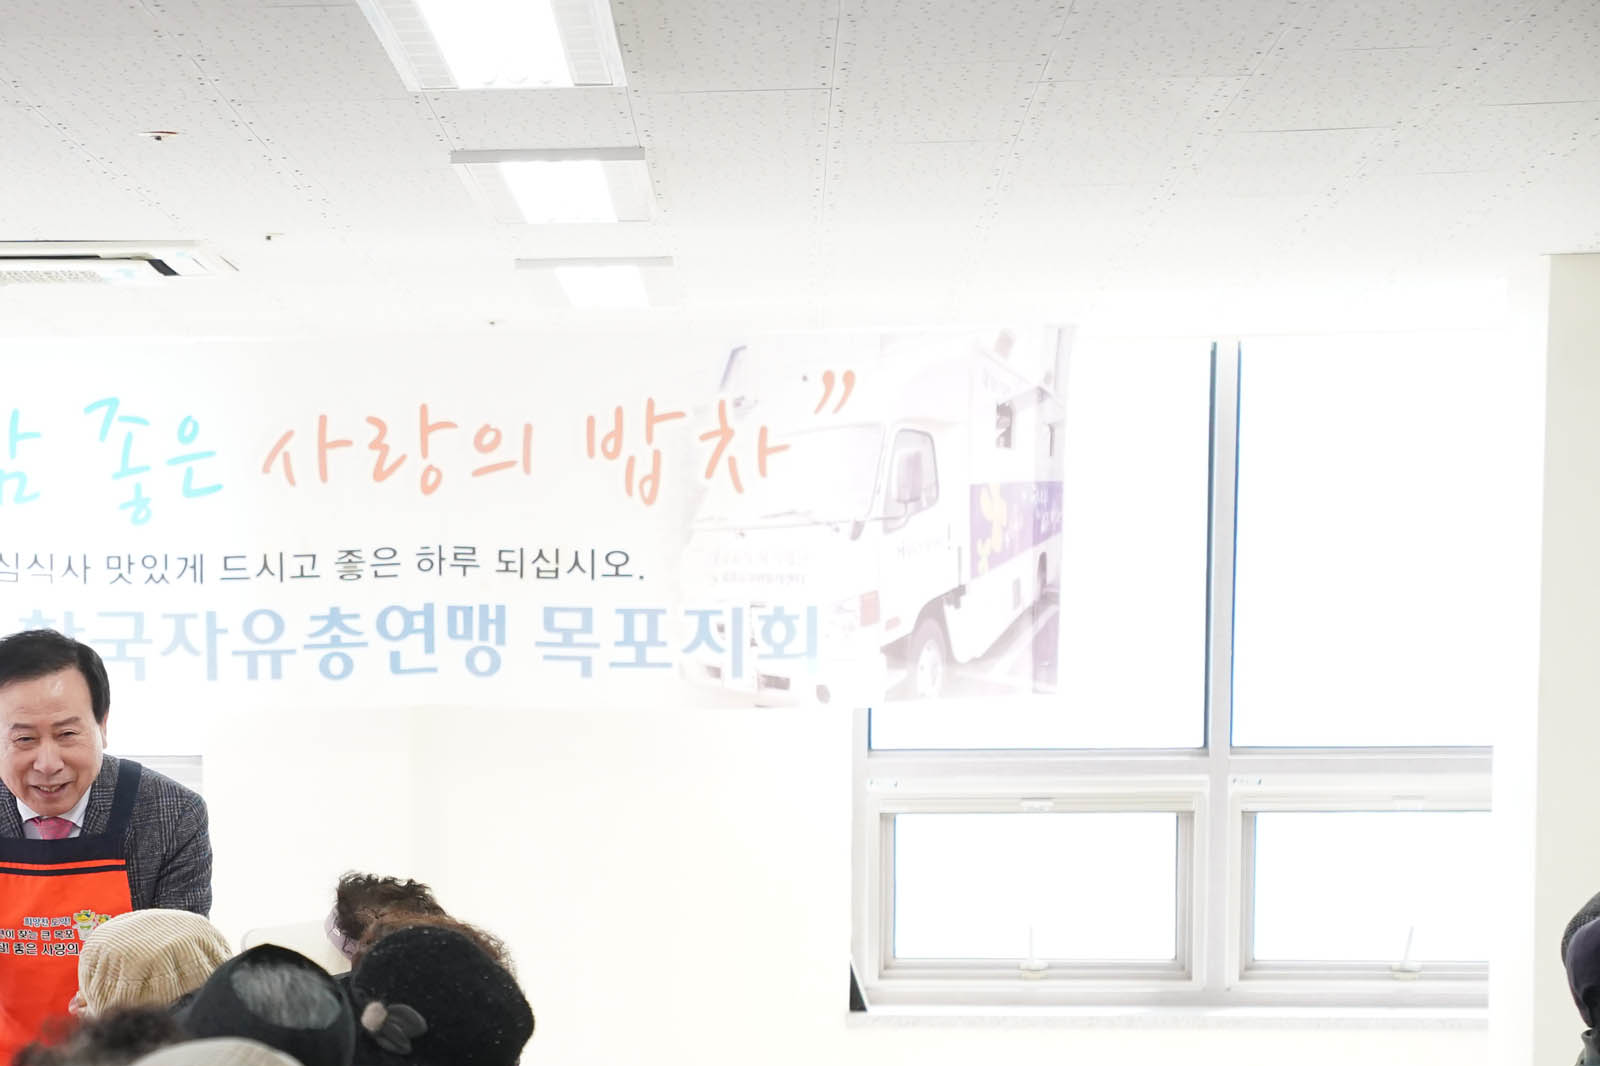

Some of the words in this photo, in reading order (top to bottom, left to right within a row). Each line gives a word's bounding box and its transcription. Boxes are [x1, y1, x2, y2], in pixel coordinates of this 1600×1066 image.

[83, 397, 225, 528] 좋은
[262, 403, 534, 497] 사랑의
[106, 553, 205, 586] 맛있게
[220, 552, 322, 584] 드시고
[335, 547, 402, 583] 좋은
[416, 545, 482, 578] 하루
[496, 547, 646, 581] 되십시오.
[535, 604, 821, 681] 목포지회
[13, 942, 38, 956] 좋은
[42, 942, 79, 956] 사랑의
